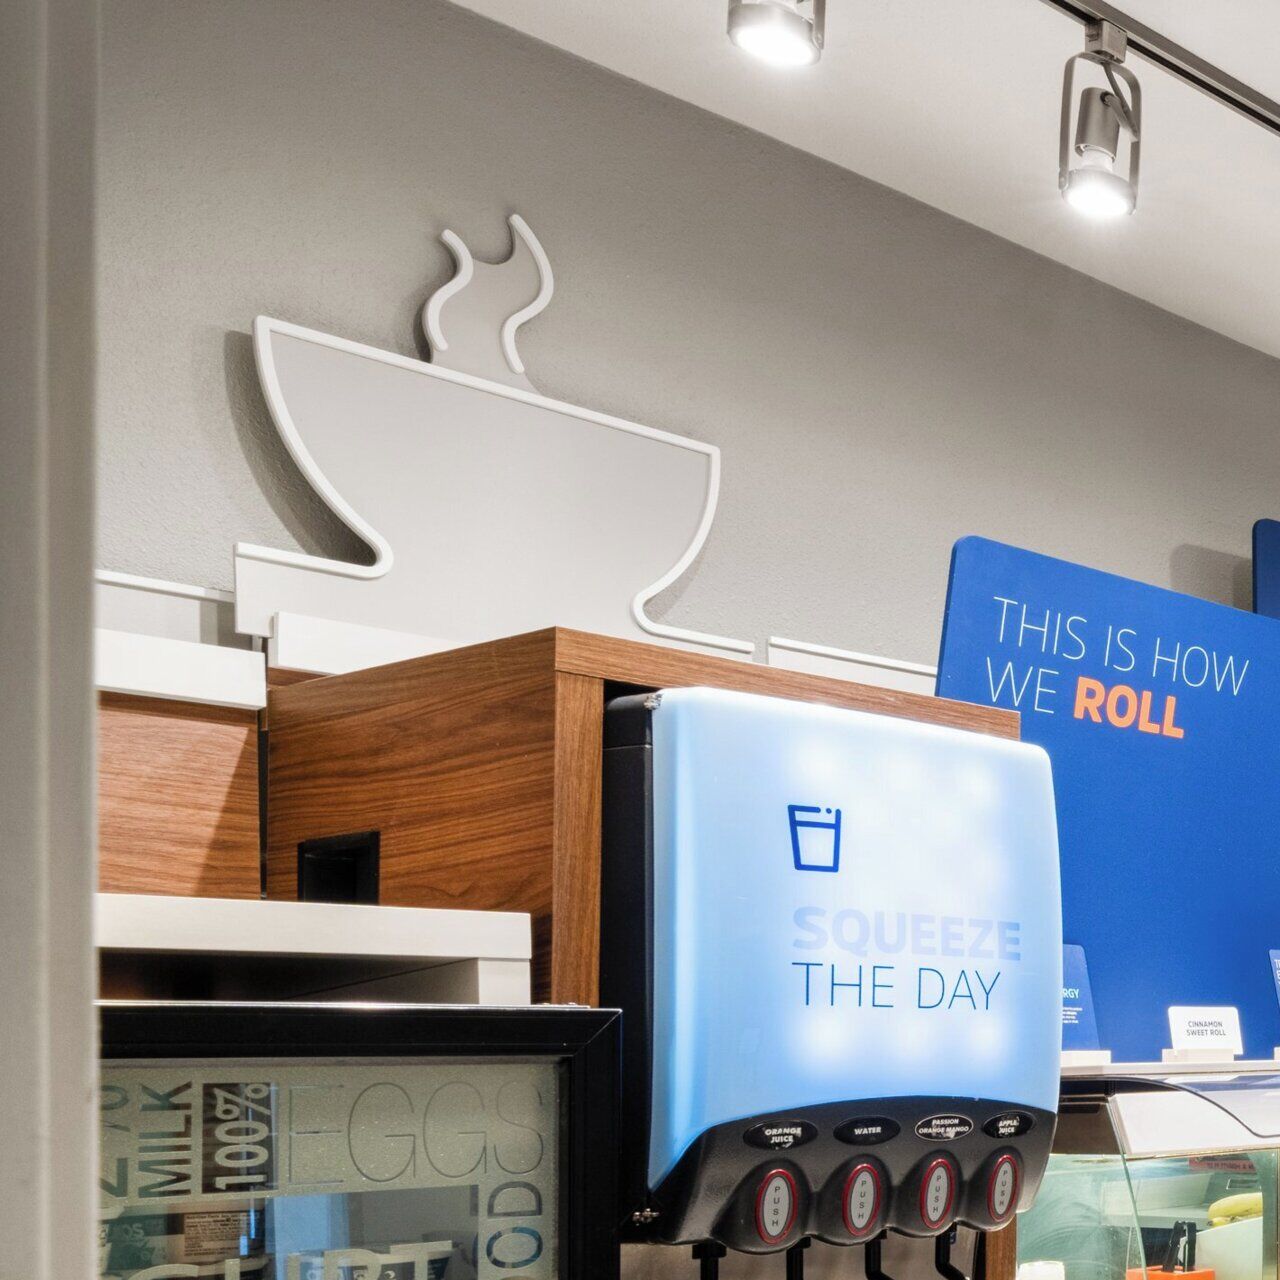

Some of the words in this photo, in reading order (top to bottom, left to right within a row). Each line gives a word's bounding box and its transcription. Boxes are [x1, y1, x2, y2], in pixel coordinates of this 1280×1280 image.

[993, 596, 1088, 661] THIS
[1104, 625, 1136, 673] IS
[1152, 637, 1250, 697] HOW
[986, 657, 1060, 715] WE
[1073, 676, 1185, 739] ROLL
[792, 905, 1022, 962] SQUEEZE
[791, 961, 895, 1009] THE
[917, 966, 1002, 1011] DAY
[1186, 1029, 1209, 1037] SWEET
[1210, 1029, 1227, 1037] ROLL
[1187, 1020, 1223, 1028] CINNAMON
[138, 1081, 192, 1198] MILK
[214, 1083, 270, 1191] 100%
[289, 1080, 545, 1186] EGGS
[764, 1127, 802, 1136] ORANGE
[770, 1135, 794, 1144] JUICE
[854, 1126, 882, 1136] WATER
[918, 1126, 945, 1134] ORANGE
[931, 1118, 959, 1126] PASSION
[771, 1186, 781, 1227] PUSH
[858, 1180, 868, 1220] PUSH
[932, 1174, 943, 1214] PUSH
[999, 1169, 1009, 1207] PUSH
